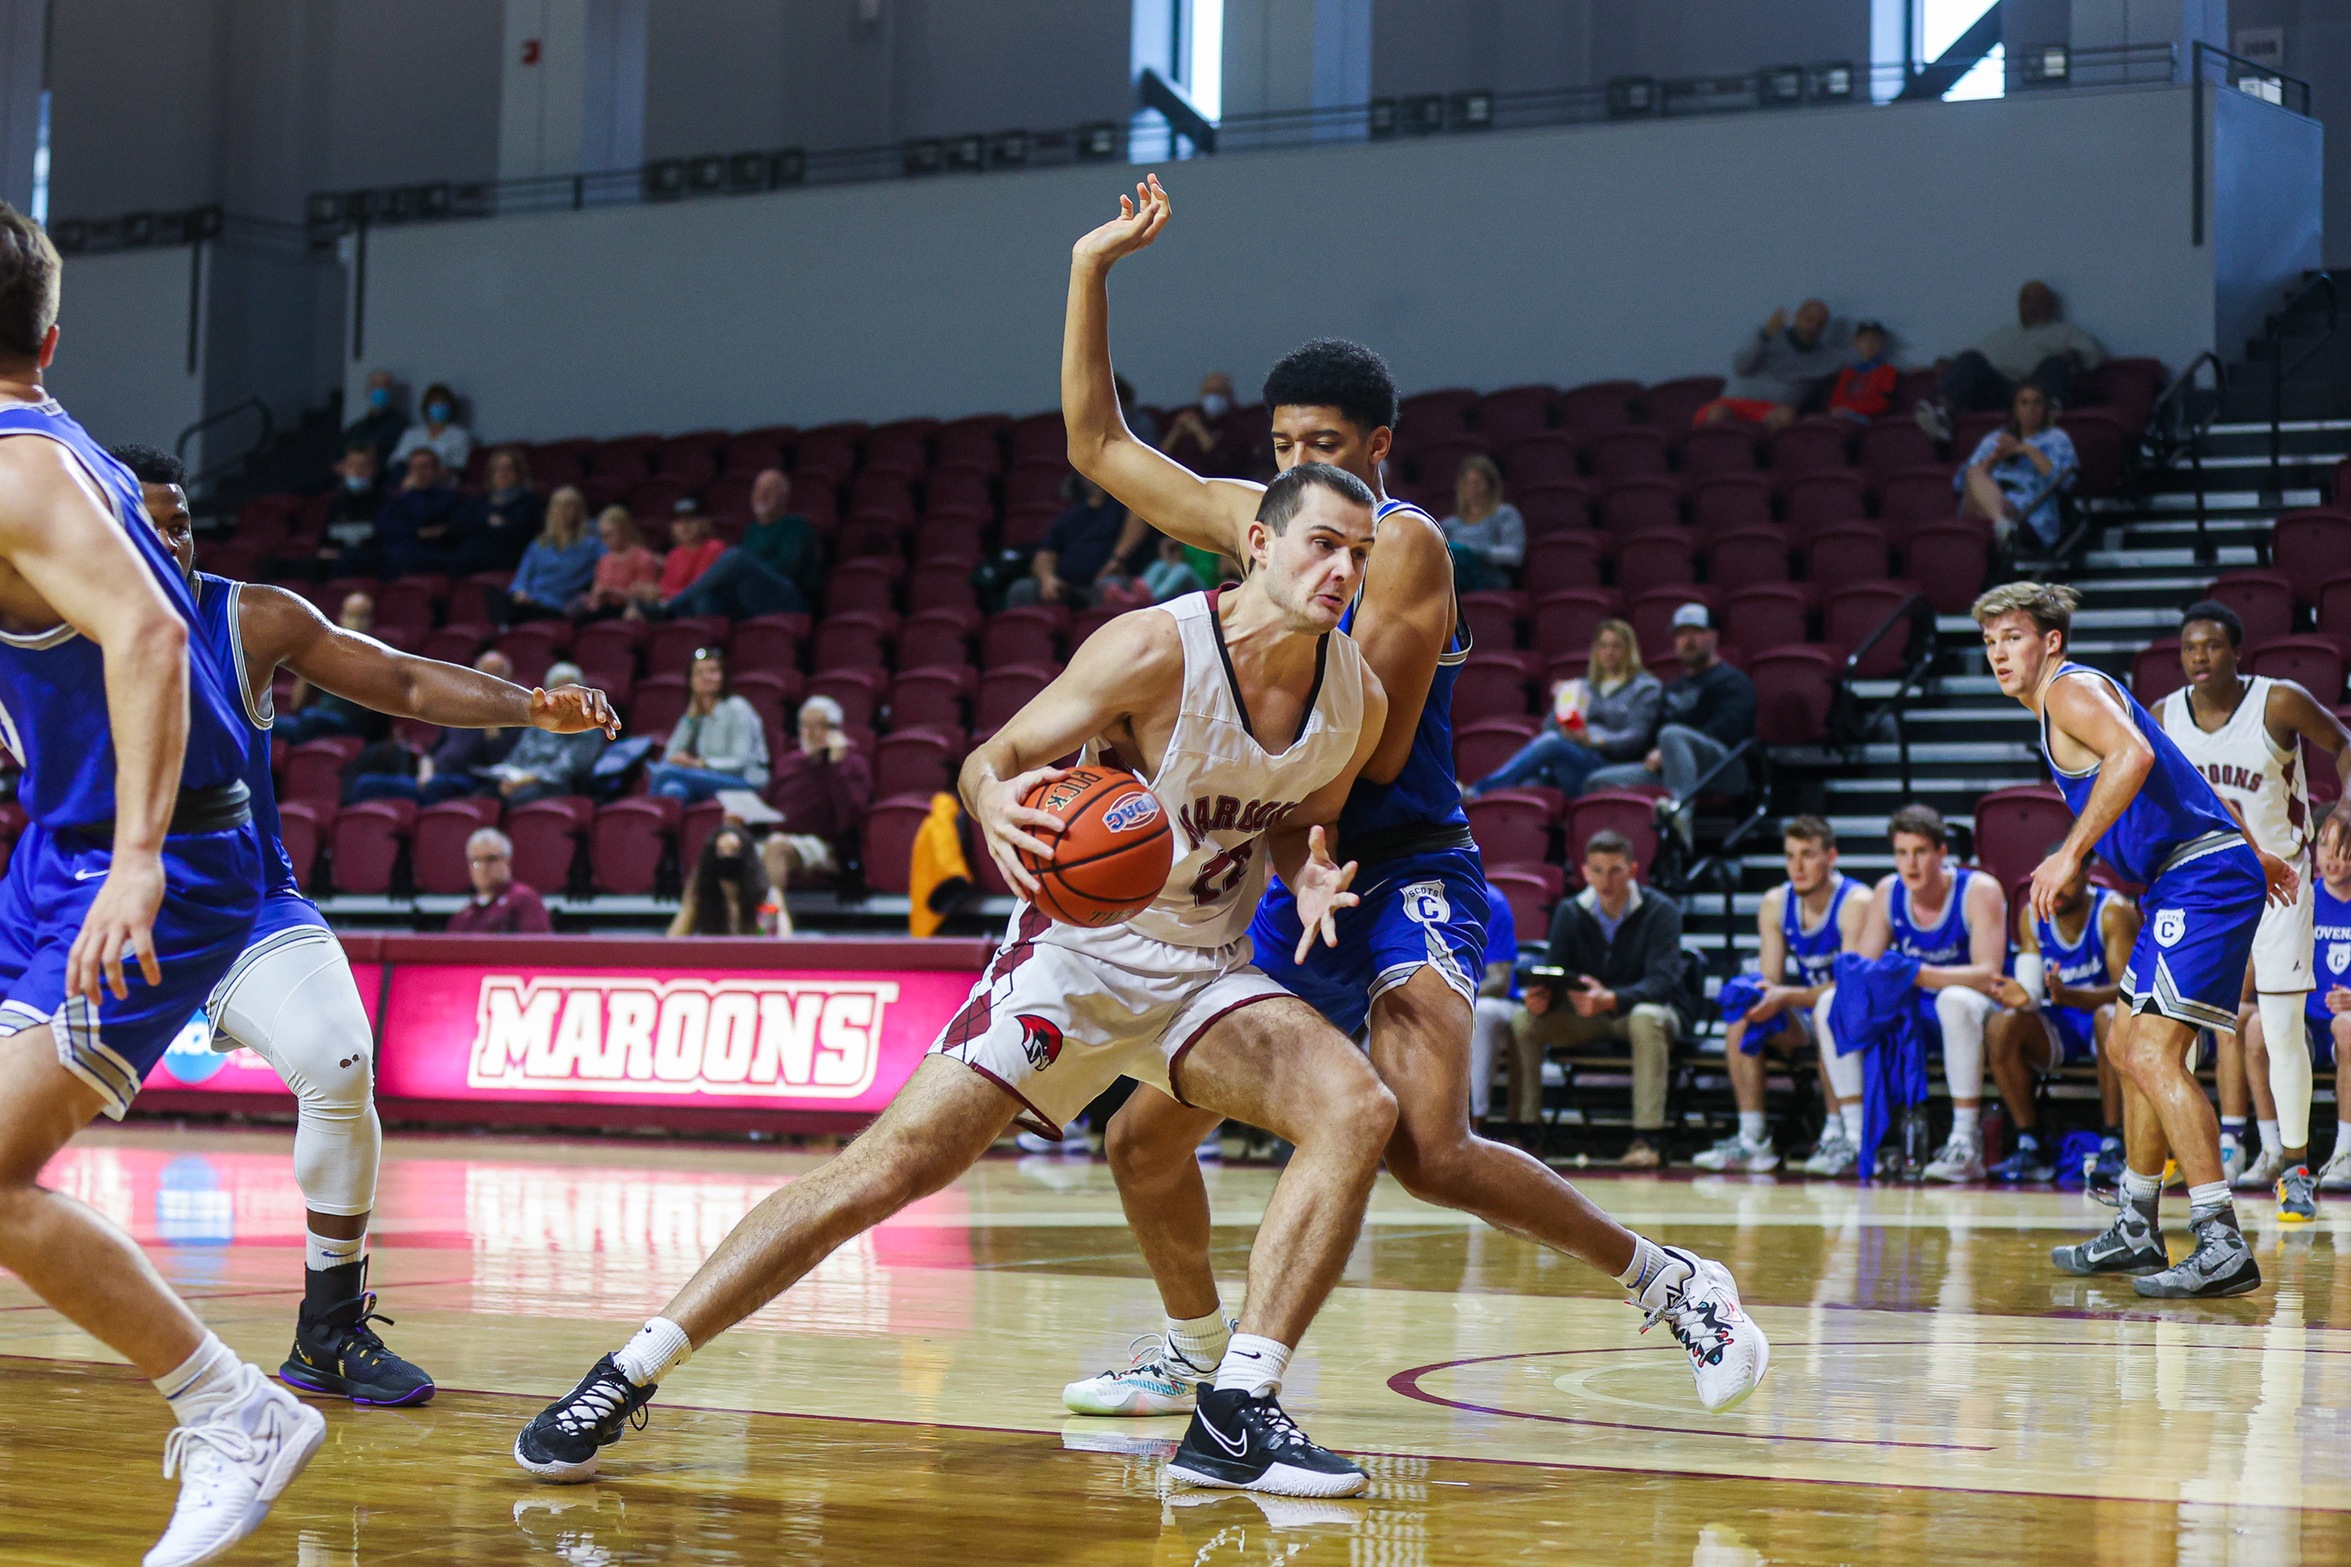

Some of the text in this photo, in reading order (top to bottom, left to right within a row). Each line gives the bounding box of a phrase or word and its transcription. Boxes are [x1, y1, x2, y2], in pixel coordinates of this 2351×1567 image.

[1408, 886, 1439, 898] SCOTS
[1417, 896, 1439, 919] C
[2161, 921, 2175, 938] C
[2314, 924, 2351, 941] OVEN
[478, 984, 877, 1089] MAROONS
